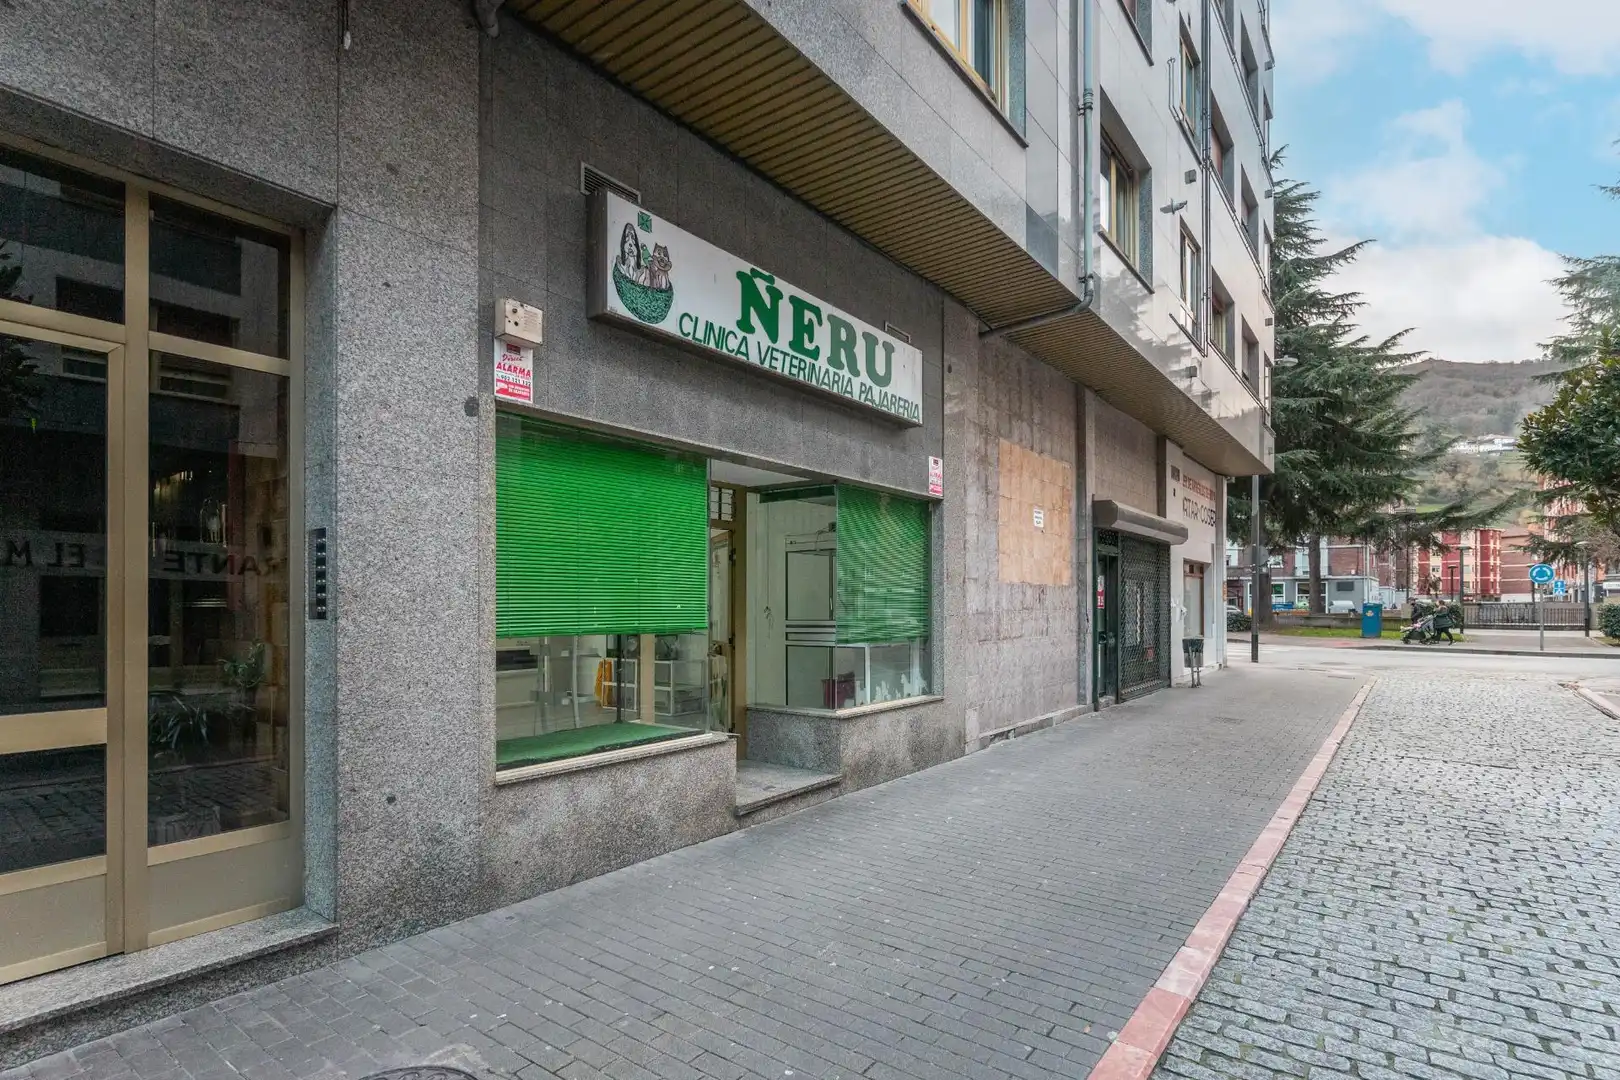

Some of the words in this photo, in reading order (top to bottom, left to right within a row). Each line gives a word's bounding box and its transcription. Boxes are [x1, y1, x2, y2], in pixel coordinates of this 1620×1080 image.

[496, 361, 532, 378] ALARMA
[679, 312, 750, 361] CLINICA
[757, 341, 854, 398] VETERINARIA
[859, 382, 920, 421] PAJARERIA
[736, 267, 895, 388] ÑERU
